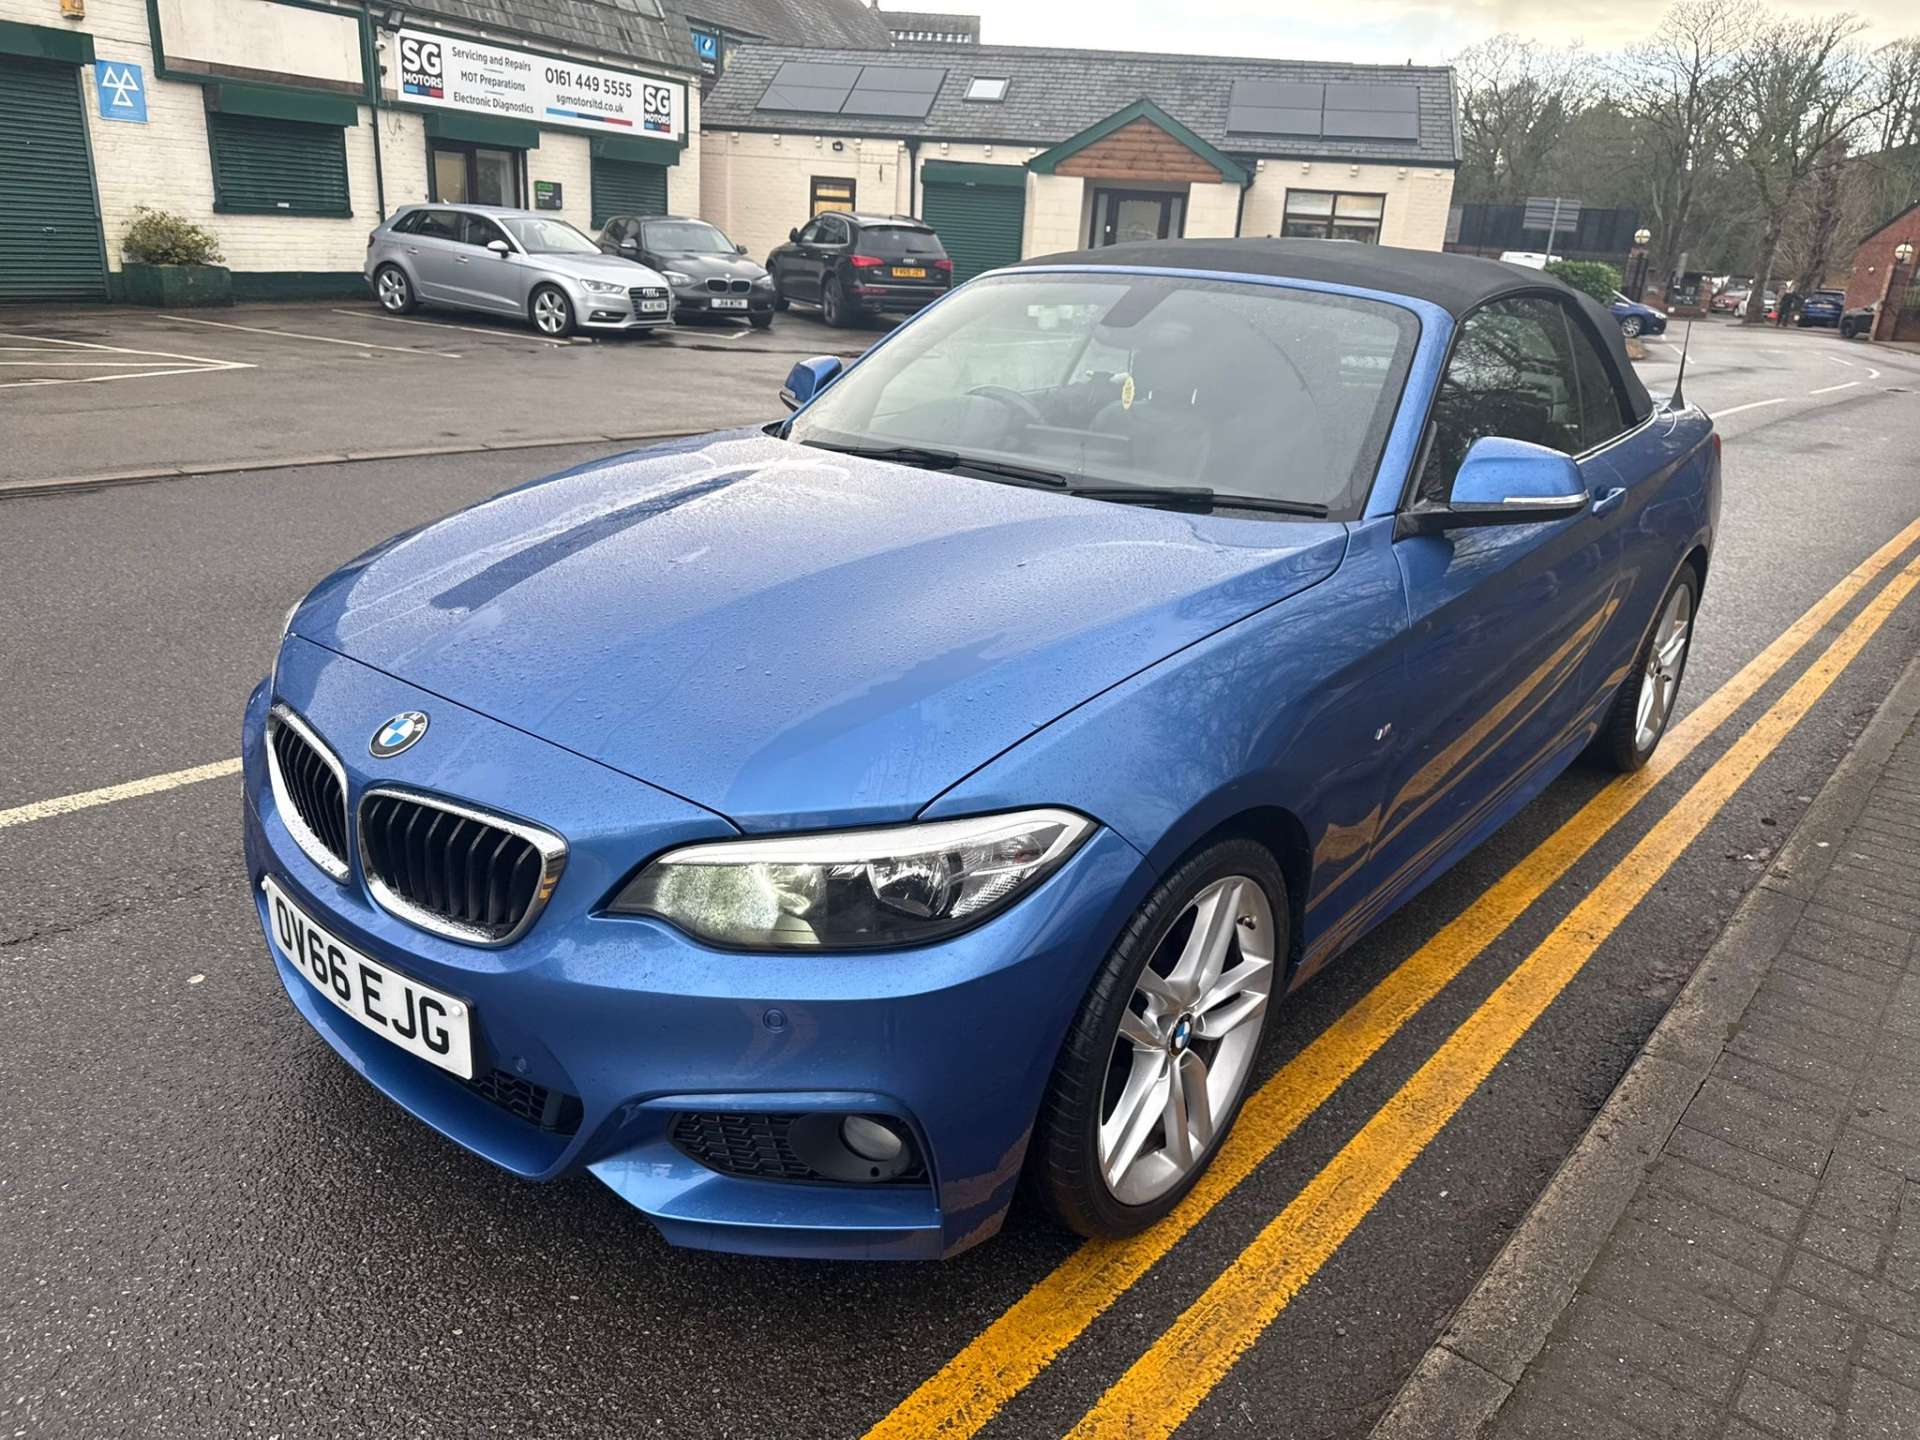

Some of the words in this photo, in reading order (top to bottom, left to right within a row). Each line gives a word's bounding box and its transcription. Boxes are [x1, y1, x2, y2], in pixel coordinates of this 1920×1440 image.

[402, 39, 442, 75] SG
[452, 46, 488, 65] Servicing
[489, 55, 504, 66] and
[504, 57, 532, 72] Repairs
[403, 71, 443, 89] MOTORS
[460, 70, 478, 84] MOT
[480, 74, 526, 91] Preparations
[545, 67, 571, 87] 0161
[575, 73, 600, 93] 449
[603, 79, 632, 98] 5555
[453, 91, 492, 108] Electronic
[492, 98, 535, 114] Diagnostics
[556, 94, 625, 113] sgmotorsltd.co.uk
[644, 86, 671, 115] SG
[644, 113, 671, 125] MOTORS
[275, 896, 352, 1002] OV66
[358, 962, 450, 1055] EJG
